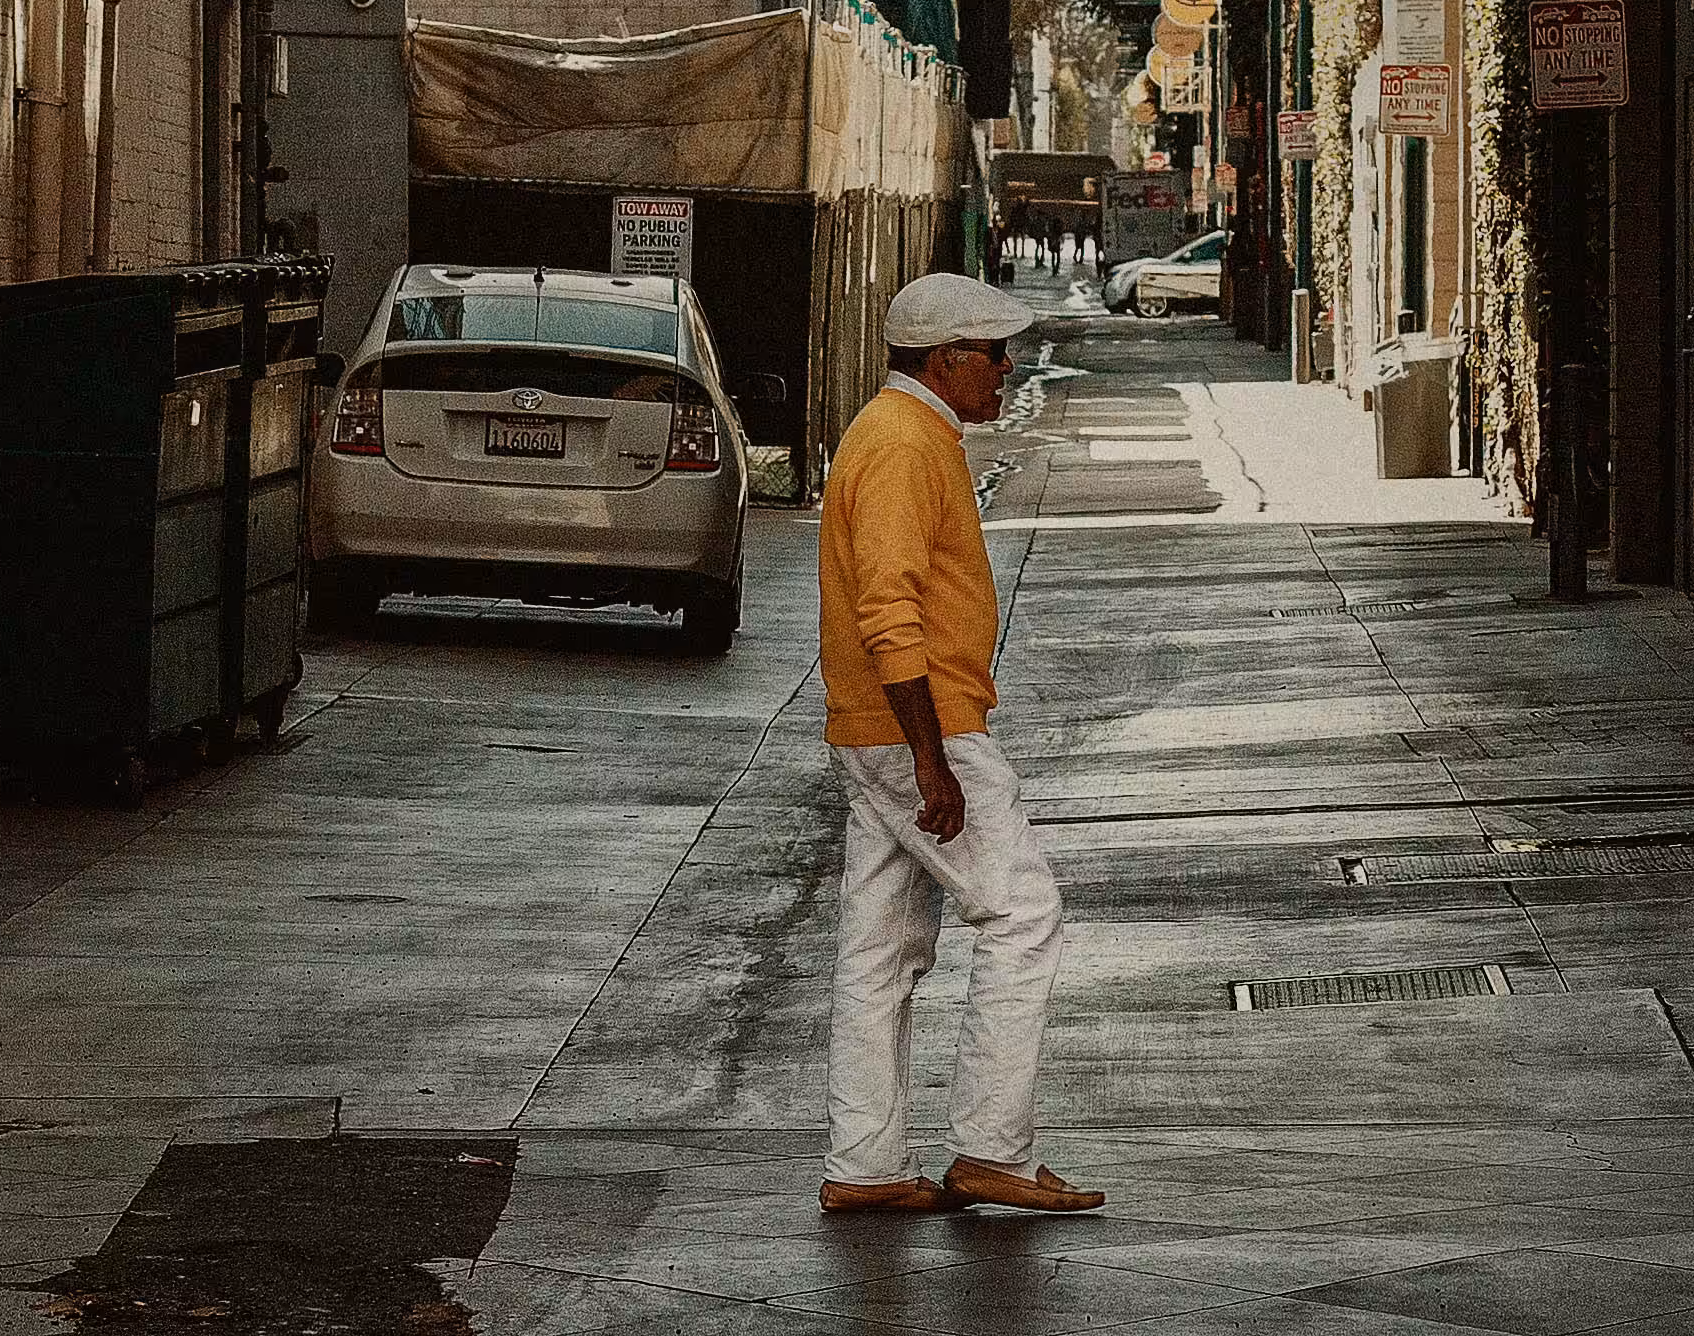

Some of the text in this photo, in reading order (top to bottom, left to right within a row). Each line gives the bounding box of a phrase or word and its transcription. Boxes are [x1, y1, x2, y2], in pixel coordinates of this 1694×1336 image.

[1536, 25, 1620, 45] NO STOPPING
[1545, 50, 1614, 70] ANY TIME
[1383, 80, 1446, 95] NO STOPPING
[1387, 98, 1441, 111] ANY TIME
[620, 202, 685, 216] TOW AWAY
[617, 219, 687, 233] NO PUBLIC
[623, 234, 681, 247] PARKING
